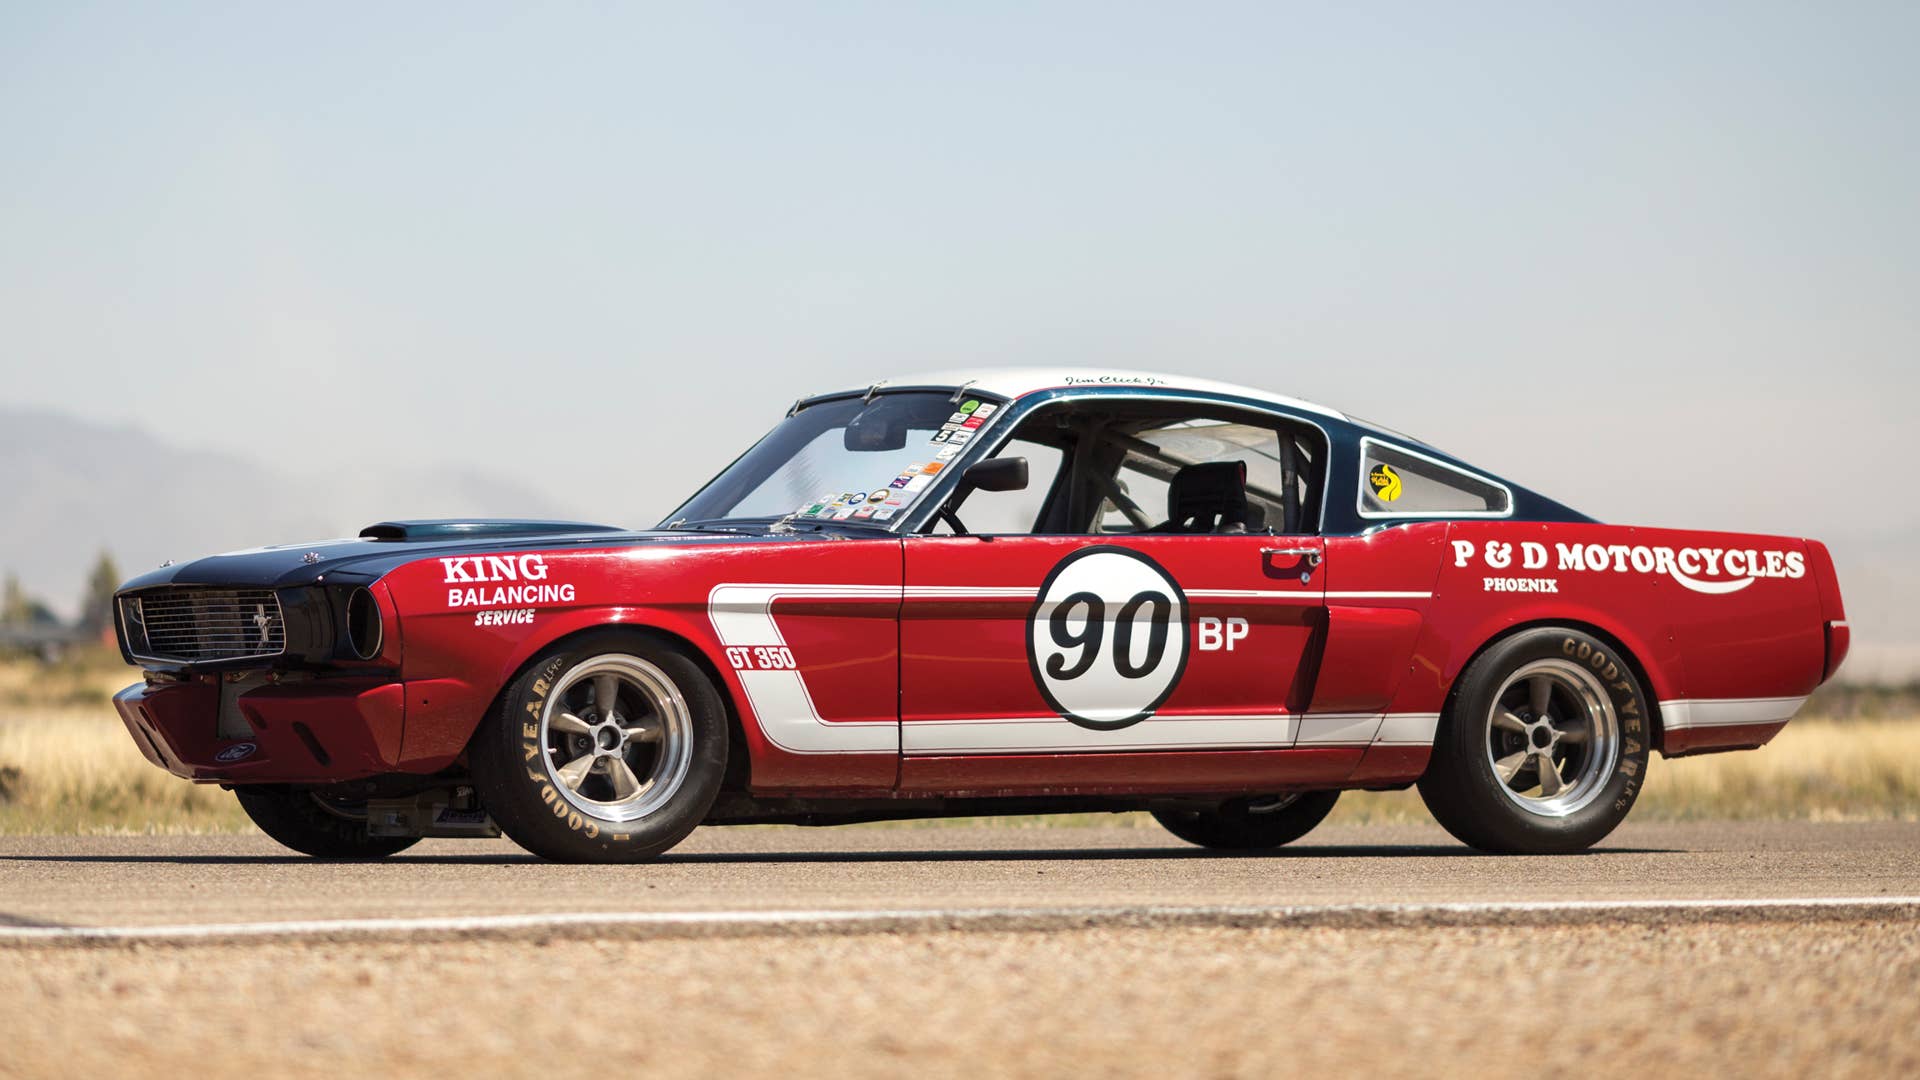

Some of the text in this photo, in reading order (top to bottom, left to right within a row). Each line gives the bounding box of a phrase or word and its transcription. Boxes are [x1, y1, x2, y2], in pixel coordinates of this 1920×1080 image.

[440, 554, 548, 584] KING
[1451, 540, 1806, 594] P & D MOTORCYCLES
[448, 584, 575, 607] BALANCING
[1483, 577, 1559, 593] PHOENIX
[474, 608, 536, 627] SERVICE
[1198, 616, 1249, 651] BP
[1046, 590, 1172, 681] 90
[725, 646, 797, 669] GT 350
[1562, 637, 1642, 778] GOODYEAR
[522, 677, 600, 840] GOODYEAR
